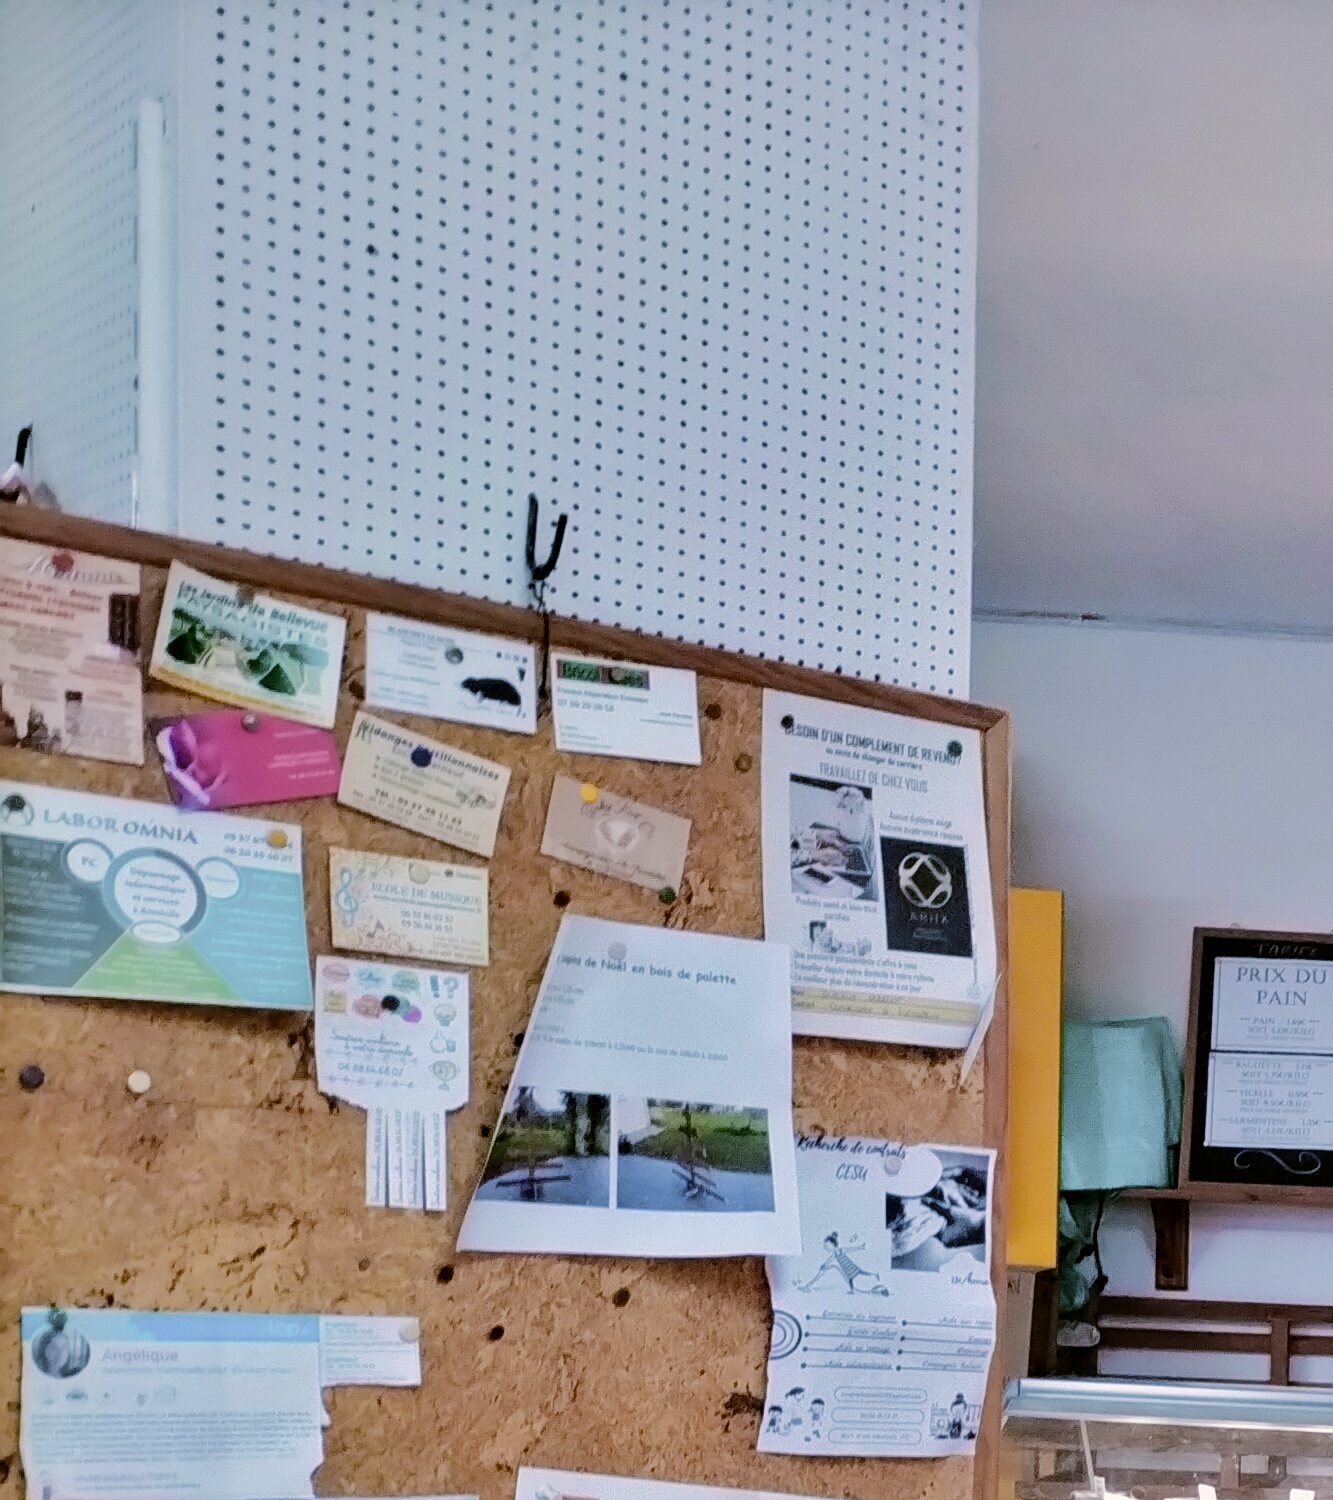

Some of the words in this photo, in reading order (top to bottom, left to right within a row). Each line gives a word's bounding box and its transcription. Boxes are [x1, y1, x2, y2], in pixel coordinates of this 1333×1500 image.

[821, 729, 843, 746] D'UN
[845, 733, 905, 757] COMPLEMENT
[907, 745, 920, 760] DE
[819, 762, 866, 782] TRAVAILLEZ
[869, 770, 879, 786] DE
[882, 773, 902, 790] CHEZ
[904, 778, 928, 794] VOUS
[43, 808, 118, 834] LABOR
[585, 957, 597, 969] de
[601, 958, 627, 973] Noël
[632, 964, 645, 975] en
[650, 963, 672, 979] bois
[677, 967, 691, 981] de
[696, 971, 737, 985] palette
[1236, 966, 1287, 984] PRIX
[1296, 968, 1327, 985] DU
[1256, 990, 1308, 1006] PAIN
[836, 1163, 868, 1182] CESU
[103, 1347, 179, 1364] Angélique
